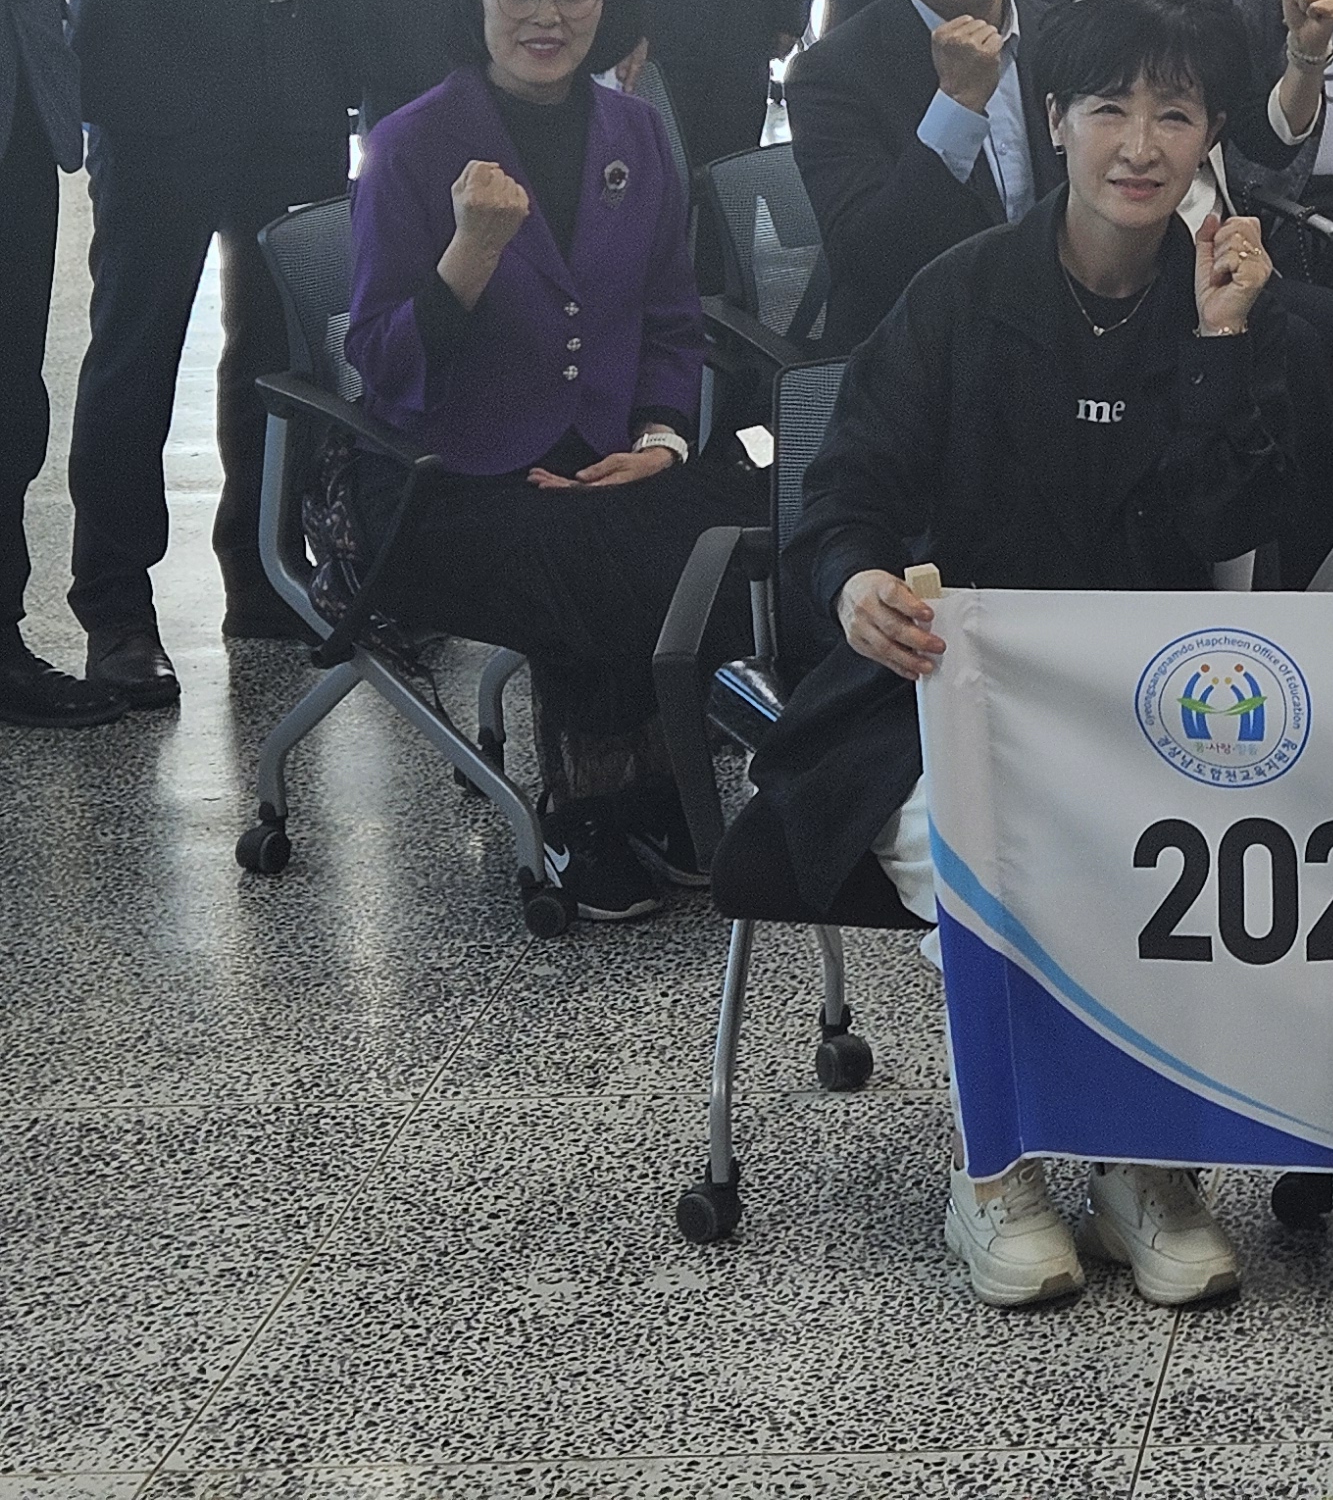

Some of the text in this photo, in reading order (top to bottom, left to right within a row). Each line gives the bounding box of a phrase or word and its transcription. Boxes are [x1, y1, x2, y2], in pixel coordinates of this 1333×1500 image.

[1076, 399, 1126, 423] me
[1196, 635, 1251, 650] Hapcheon
[1253, 643, 1281, 666] Office
[1278, 663, 1290, 675] Of
[1286, 675, 1305, 730] Education
[1157, 735, 1298, 783] 경상남도합천교육지원청
